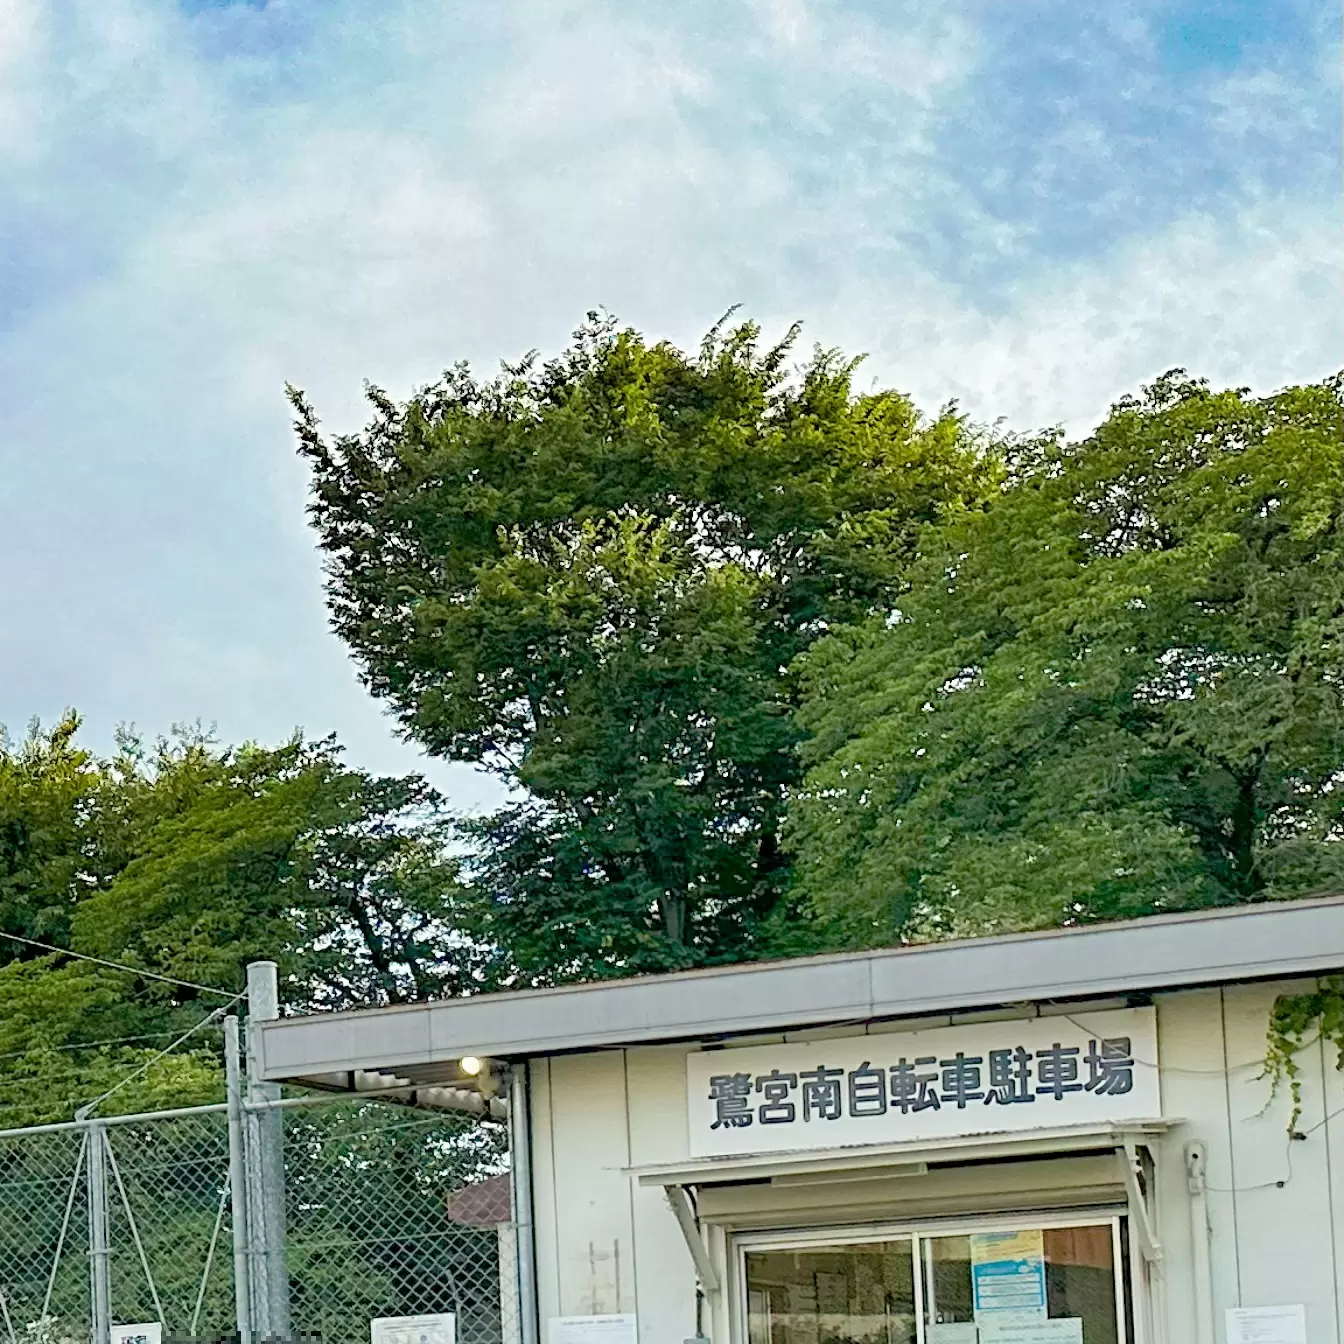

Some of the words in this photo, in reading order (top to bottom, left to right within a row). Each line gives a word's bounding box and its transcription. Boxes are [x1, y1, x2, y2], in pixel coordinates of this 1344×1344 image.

[709, 1036, 1135, 1130] 鷺宮南自転車駐車場
